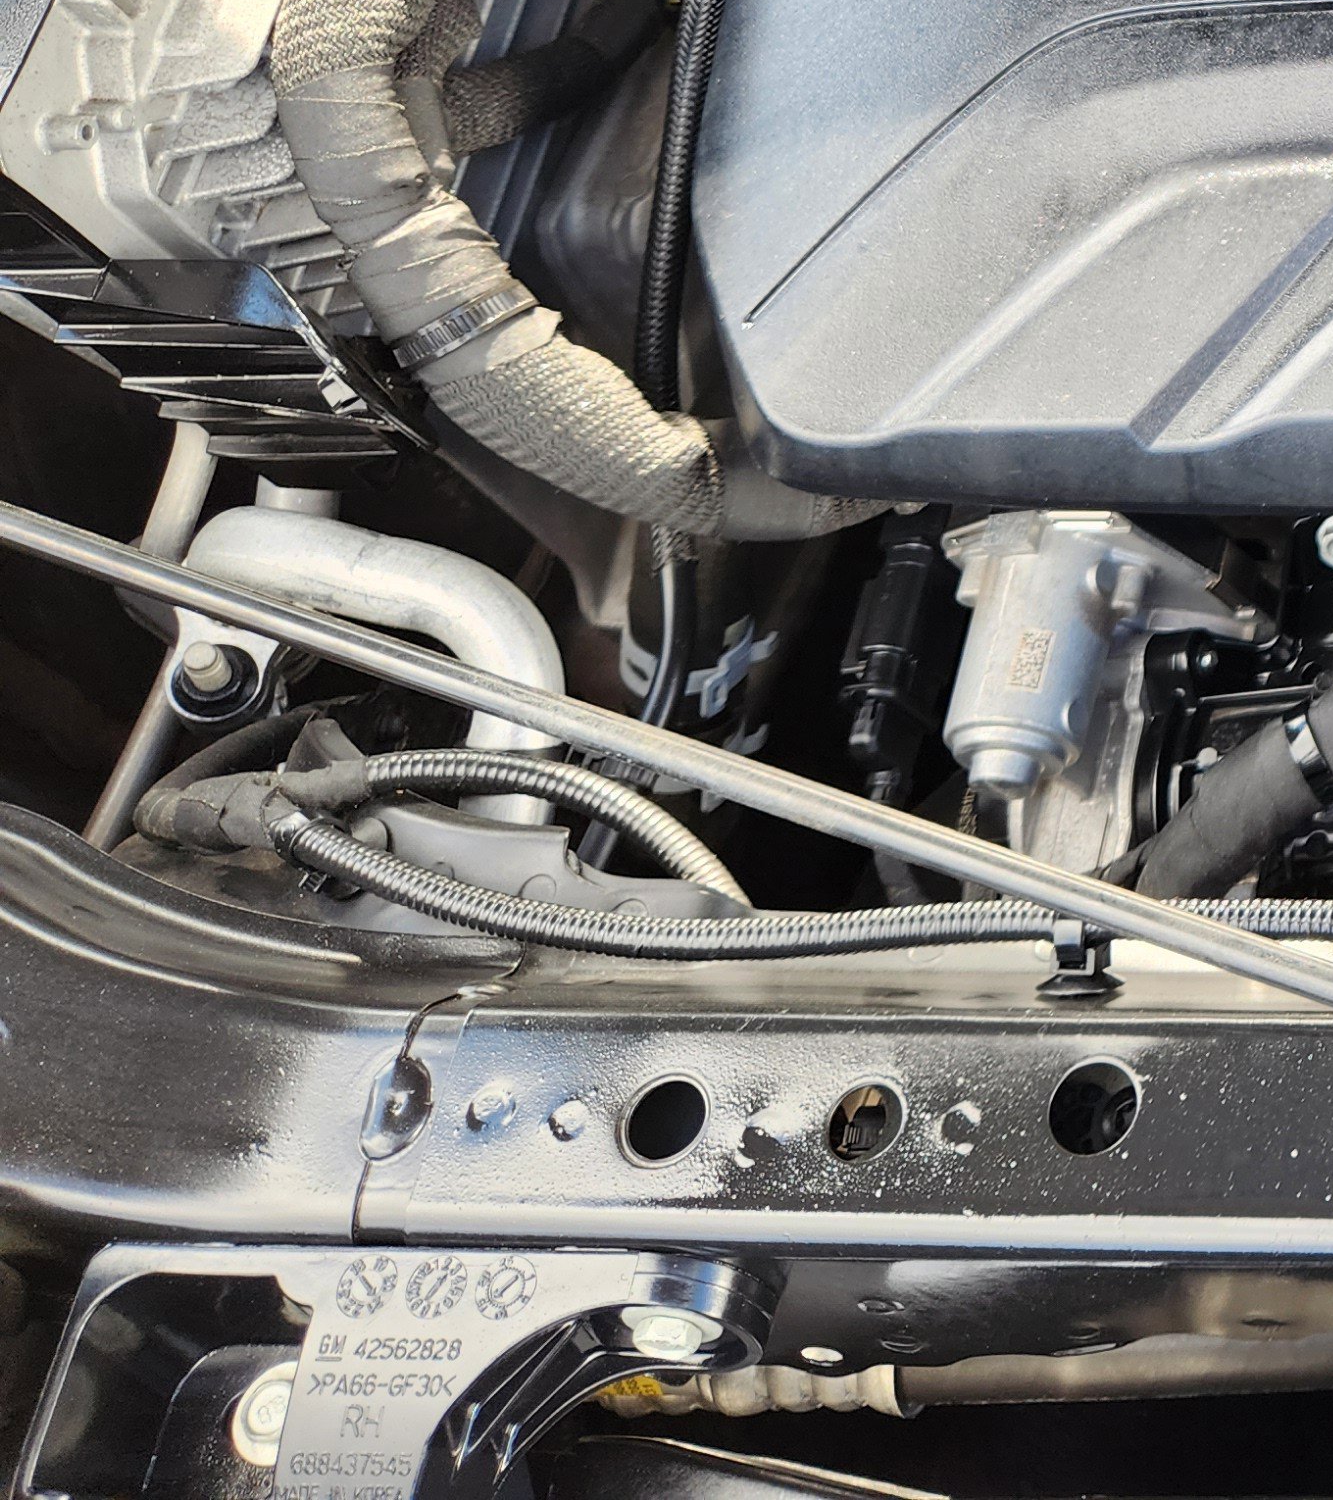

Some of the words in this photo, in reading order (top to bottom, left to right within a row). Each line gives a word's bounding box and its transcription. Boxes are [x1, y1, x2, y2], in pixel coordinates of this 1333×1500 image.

[317, 1334, 347, 1355] GM
[353, 1338, 463, 1361] 42562828
[339, 1403, 386, 1439] RH
[289, 1452, 414, 1477] 688437545
[274, 1484, 320, 1500] MADE
